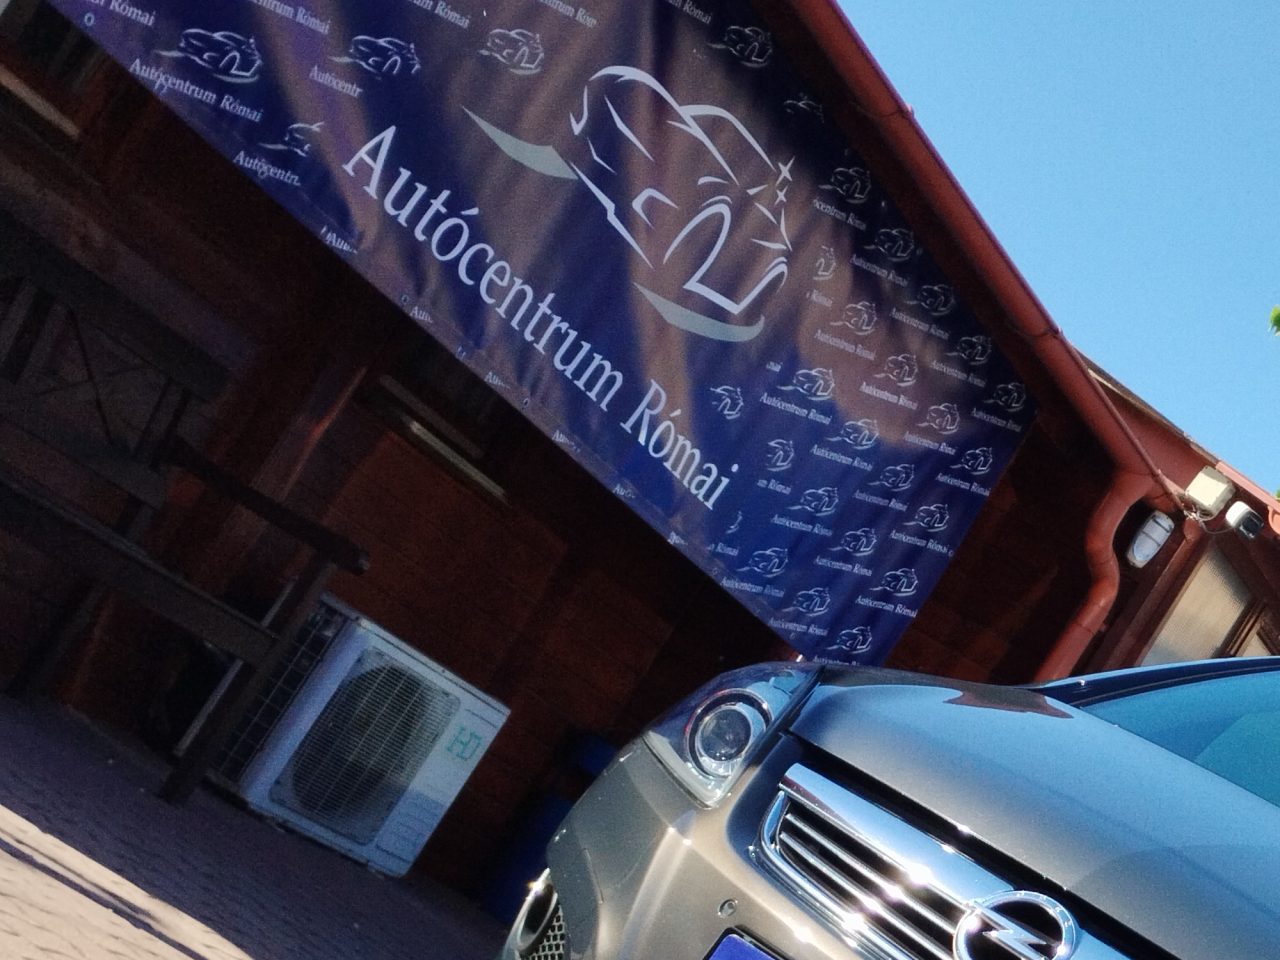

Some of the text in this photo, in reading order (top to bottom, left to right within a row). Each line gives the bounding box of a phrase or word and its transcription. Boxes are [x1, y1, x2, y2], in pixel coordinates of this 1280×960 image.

[128, 58, 264, 123] Autócentrum Római
[342, 125, 740, 511] Autócentrum Római
